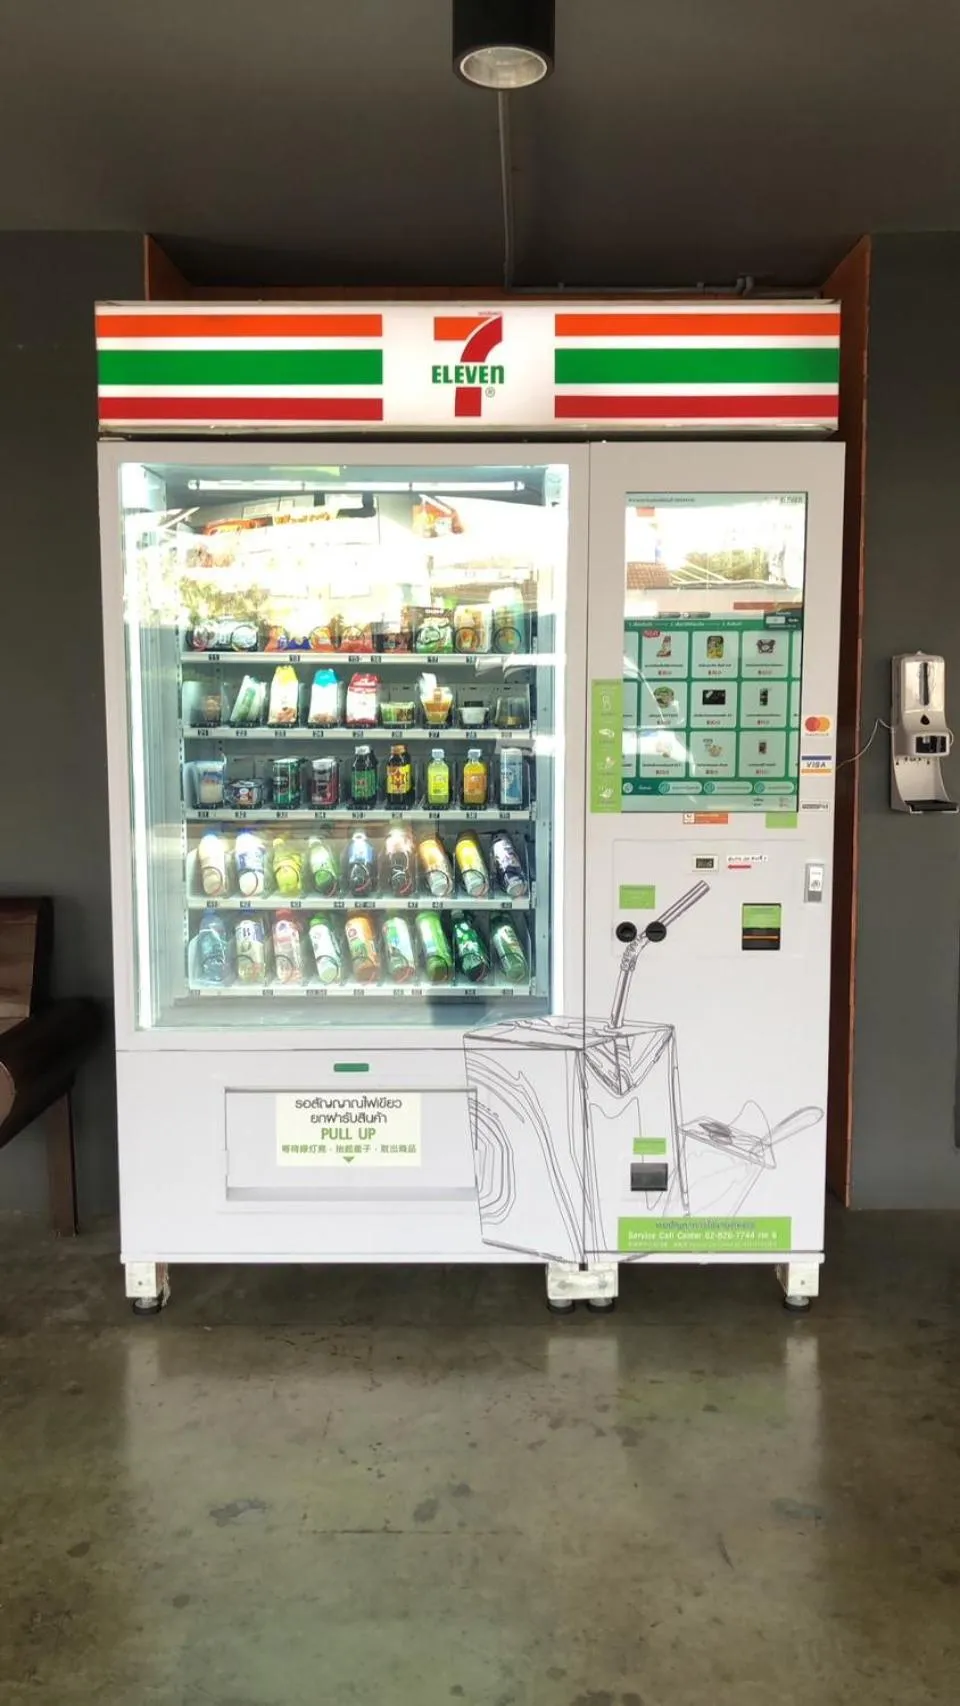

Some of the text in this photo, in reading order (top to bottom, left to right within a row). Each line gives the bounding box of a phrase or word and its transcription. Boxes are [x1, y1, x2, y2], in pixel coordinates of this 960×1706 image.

[433, 316, 503, 417] 7
[806, 761, 827, 769] VISA
[321, 1127, 376, 1140] PULL UP
